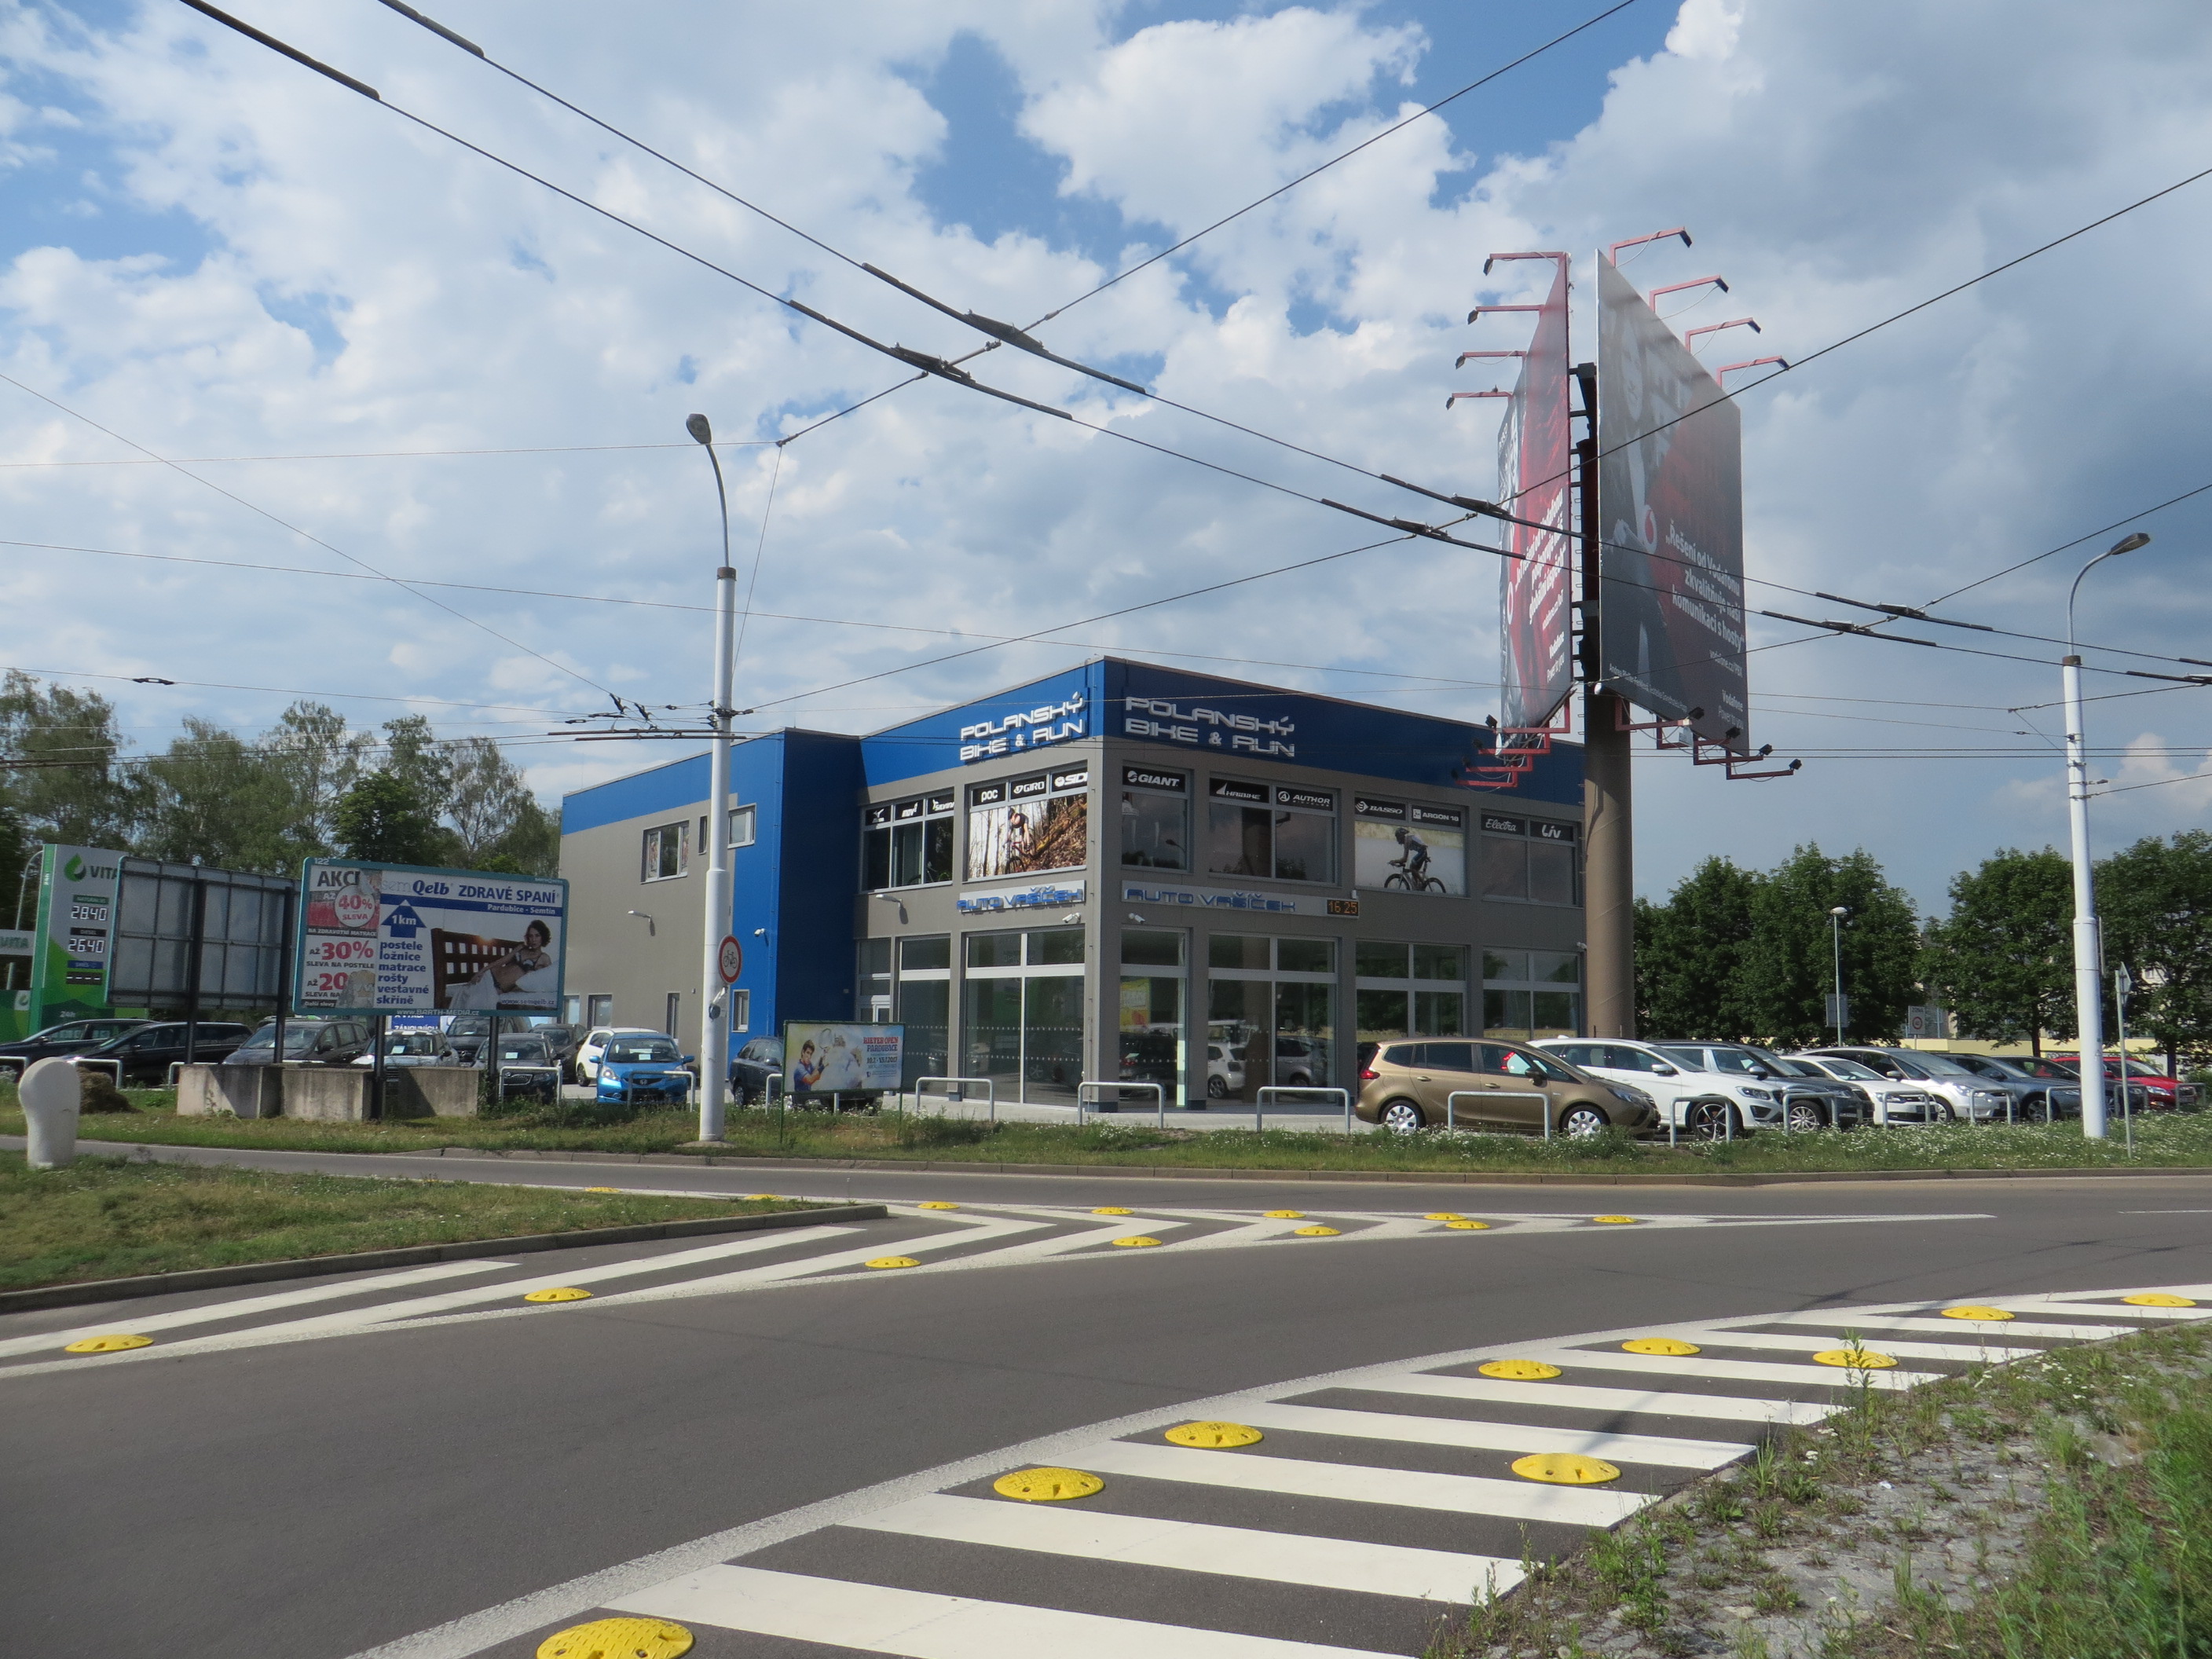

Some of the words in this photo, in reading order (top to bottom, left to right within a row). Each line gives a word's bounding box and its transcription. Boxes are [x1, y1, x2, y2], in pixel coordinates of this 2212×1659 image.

[1697, 552, 1706, 571] od
[1672, 584, 1717, 632] komunikaci
[1717, 622, 1723, 637] s
[961, 691, 1084, 741] POLANSKÝ
[1126, 696, 1295, 736] POLANSKÝ
[960, 737, 1007, 760] BIKE
[1015, 733, 1025, 747] &
[1032, 718, 1084, 744] RUN
[1126, 718, 1198, 743] BIKE
[1209, 731, 1221, 745] &
[1232, 734, 1295, 758] RUN
[1024, 781, 1045, 793] GIRO
[1138, 774, 1179, 787] GIANT
[1293, 794, 1331, 804] AUTHOR
[1369, 805, 1403, 815] BASSO
[1485, 819, 1517, 832] Electra
[1541, 825, 1562, 839] Liv
[458, 884, 512, 900] ZDRAVÉ
[516, 888, 556, 903] SPANÍ
[1124, 888, 1193, 903] AUTO
[488, 903, 524, 913] Pardubice
[957, 897, 1003, 910] AUTO
[321, 940, 374, 960] 30%
[380, 941, 423, 951] postele
[379, 950, 420, 961] ložnice
[379, 963, 426, 972] matrace
[378, 973, 408, 983] rošty
[378, 985, 429, 994] vestavné
[377, 994, 414, 1004] skříně
